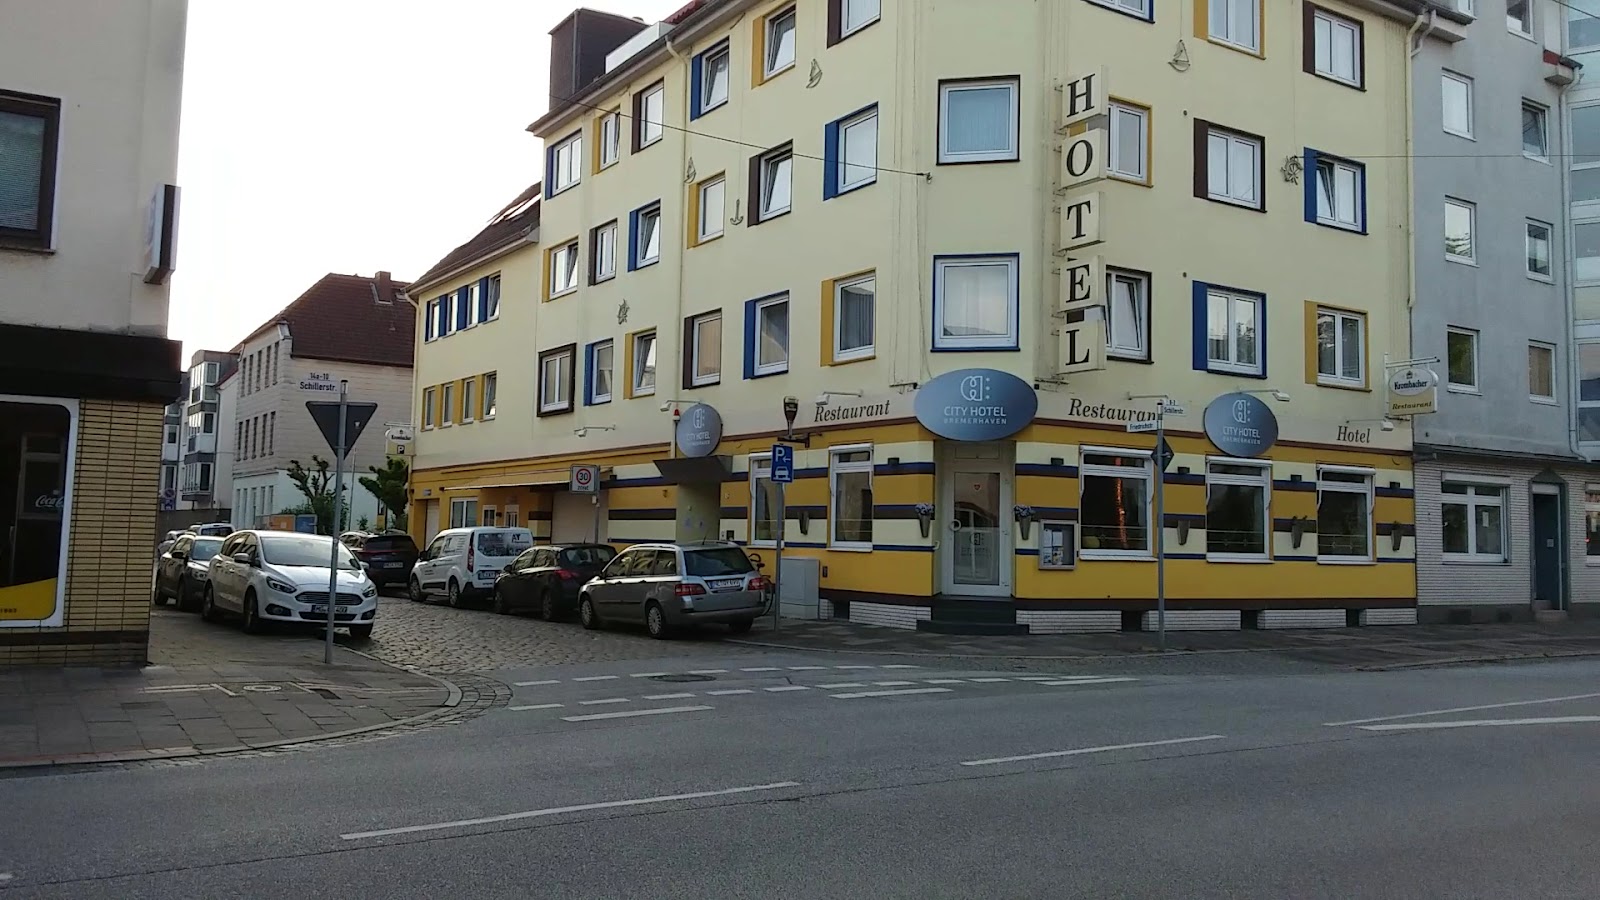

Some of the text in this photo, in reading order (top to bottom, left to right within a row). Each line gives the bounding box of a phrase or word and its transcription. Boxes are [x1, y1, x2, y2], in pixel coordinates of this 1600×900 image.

[1065, 73, 1096, 366] HOTEL
[1394, 380, 1428, 390] Krombacher
[814, 399, 891, 422] Restaurant
[944, 406, 1007, 417] CITY HOTEL
[1068, 398, 1157, 422] Restauran
[1392, 401, 1433, 410] Restaurant
[1222, 426, 1261, 438] CITY HOTEL
[1336, 425, 1371, 444] Hotel
[775, 446, 785, 463] P
[579, 472, 589, 481] 30
